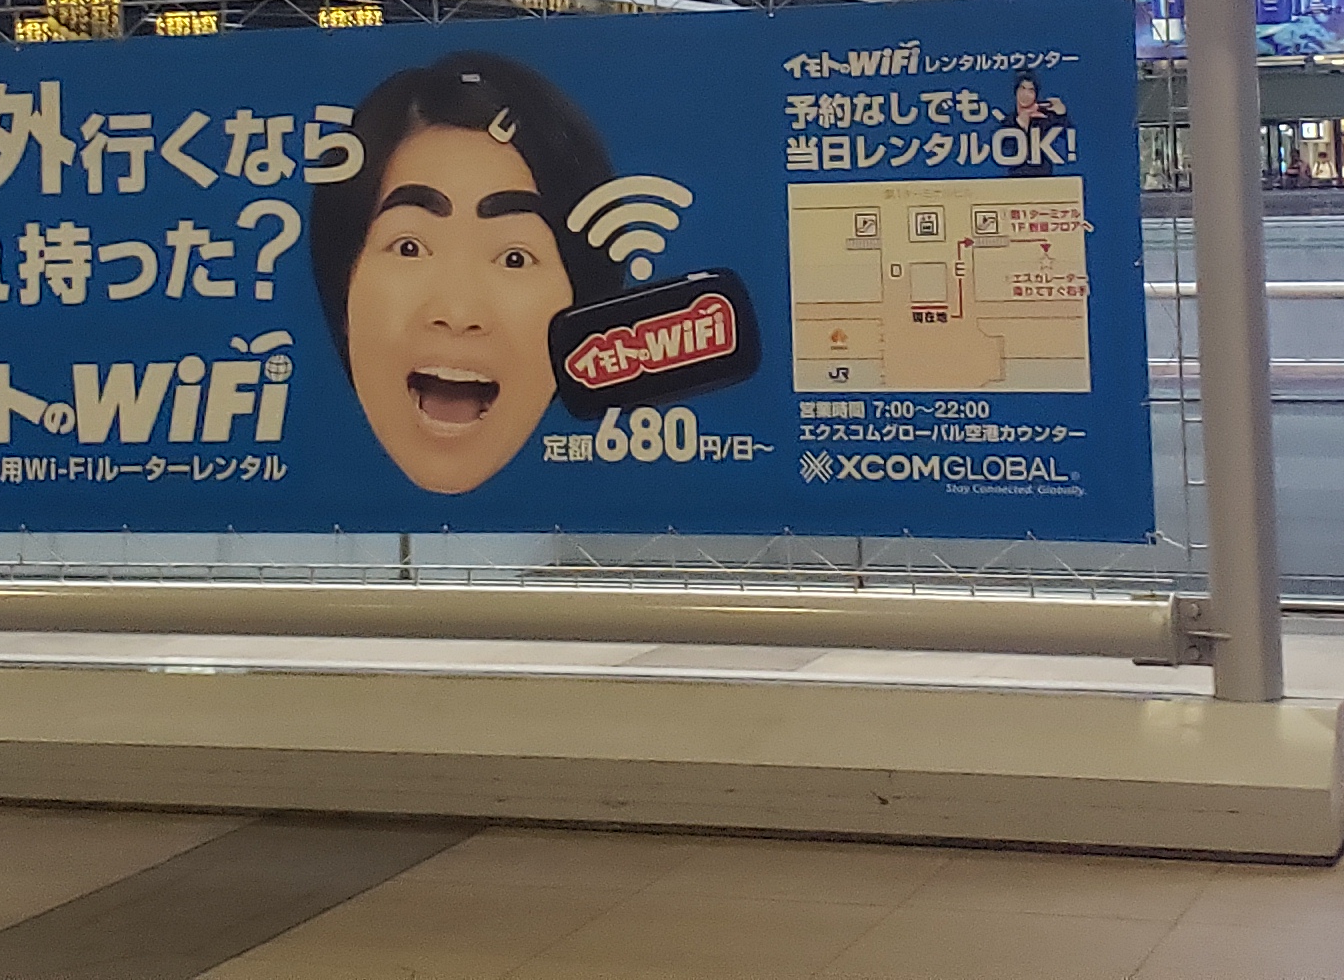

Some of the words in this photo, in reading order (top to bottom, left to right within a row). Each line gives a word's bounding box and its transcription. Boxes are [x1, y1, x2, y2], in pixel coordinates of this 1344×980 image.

[924, 52, 1079, 72] レンタルカウンター
[785, 89, 1006, 130] 予約なしでも、
[828, 368, 849, 380] JR
[799, 424, 1086, 442] エクスコムグローバル空港カウンター
